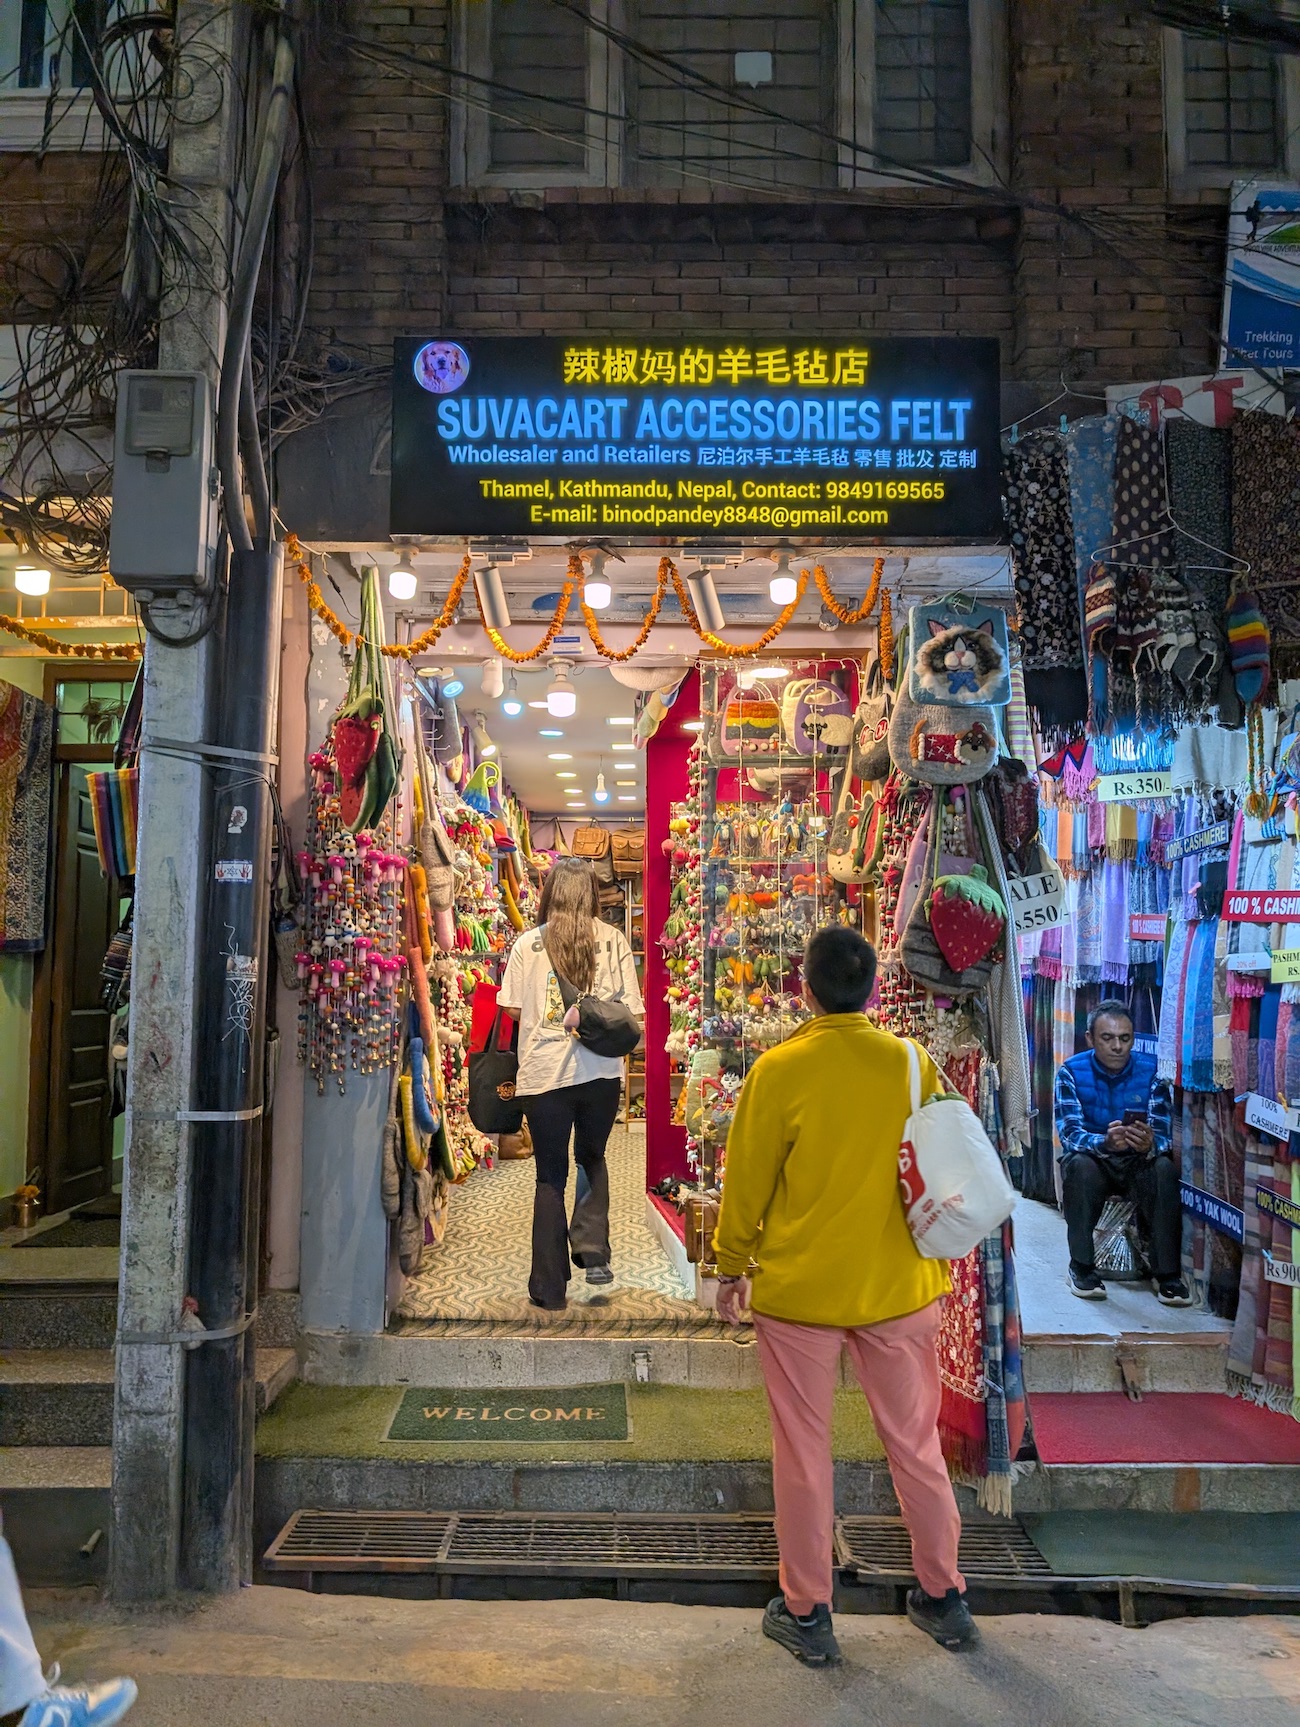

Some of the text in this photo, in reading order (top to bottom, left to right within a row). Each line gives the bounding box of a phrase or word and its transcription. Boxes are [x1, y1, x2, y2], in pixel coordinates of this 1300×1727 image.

[1244, 330, 1293, 345] Trekking
[1231, 347, 1294, 360] Tbet Tours
[563, 348, 868, 385] 辣椒妈的羊毛毡店
[437, 398, 971, 442] SUVACART ACCESSORIES FELT
[448, 444, 558, 463] Wholesaler
[562, 444, 598, 463] and
[603, 444, 691, 464] Retailers
[698, 447, 849, 466] 尼泊尔手工羊毛毡
[854, 448, 892, 468] 零售
[939, 449, 977, 468] 定制
[480, 480, 945, 503] Thamel, Kathmandu, Nepal, Contact: 9849169565
[530, 506, 888, 527] E-mail: binodpandey8848@gmail.com
[1114, 777, 1170, 796] Rs.350/-
[1166, 825, 1226, 859] 100% CASHMERE
[1229, 896, 1249, 914] 100
[1252, 897, 1261, 915] %
[1261, 1099, 1278, 1114] 100%
[1251, 1113, 1289, 1139] CASHMERE
[1180, 1188, 1242, 1235] 100 % YAK WOOL
[1257, 1191, 1273, 1211] 100%
[423, 1407, 606, 1421] WELCOME
